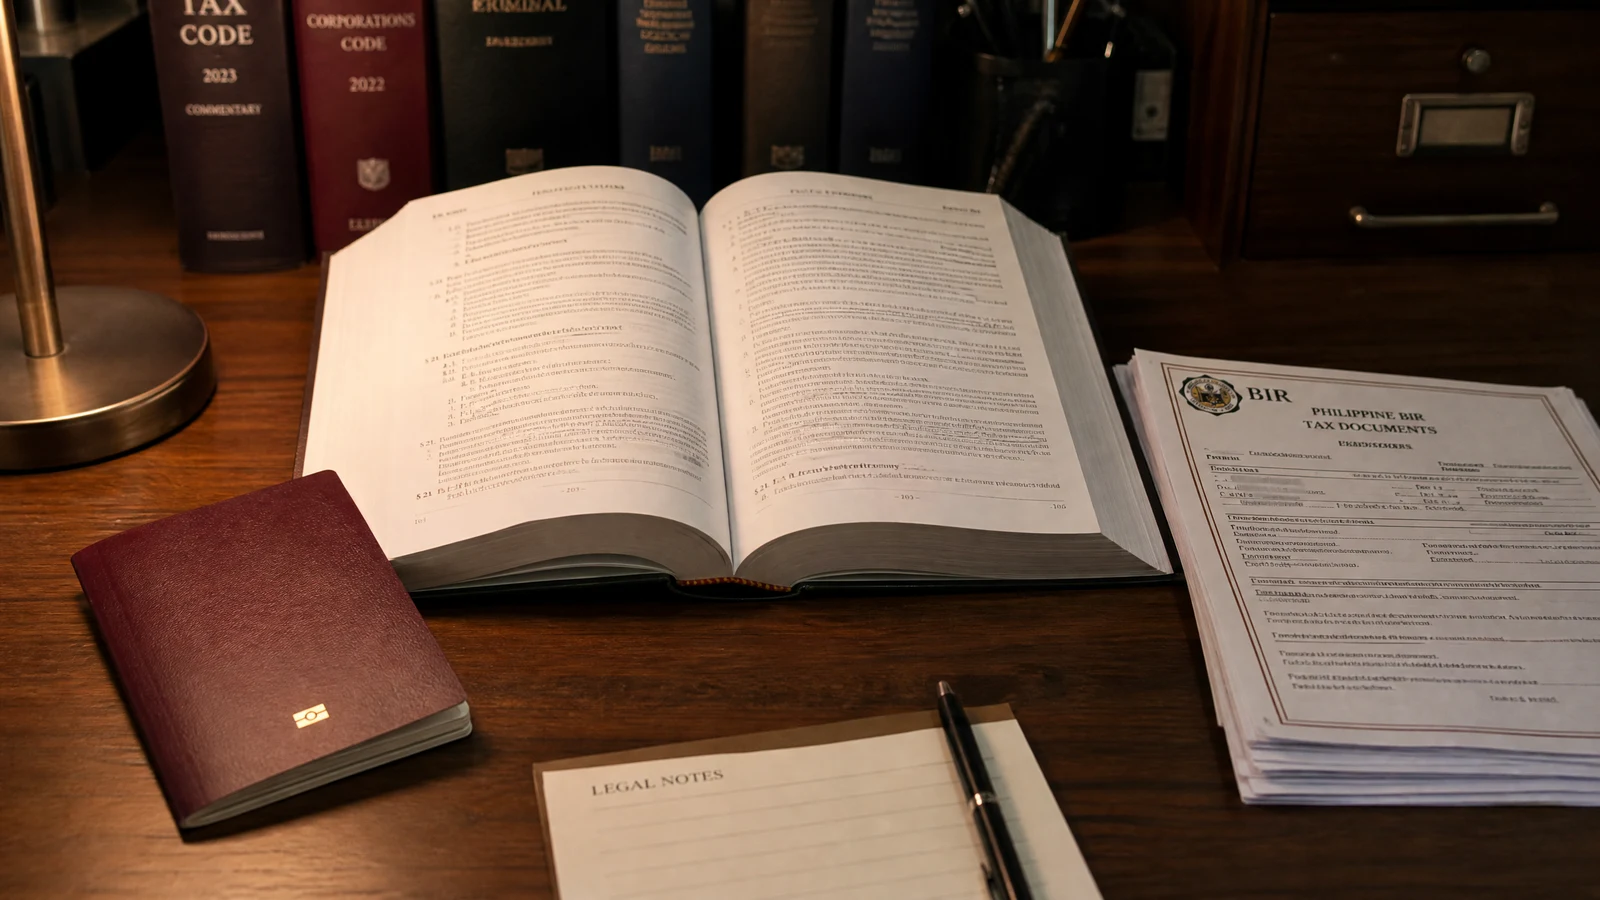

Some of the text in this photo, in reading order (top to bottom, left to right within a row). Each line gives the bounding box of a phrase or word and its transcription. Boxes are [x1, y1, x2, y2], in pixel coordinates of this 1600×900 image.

[183, 0, 248, 16] TAX
[306, 13, 416, 29] CORPORATIONS
[180, 24, 254, 46] CODE
[340, 36, 387, 52] CODE
[202, 68, 238, 84] 2023
[349, 77, 386, 92] 2022
[185, 103, 262, 116] COMMENTARY
[1246, 387, 1293, 403] BIR
[1311, 407, 1426, 421] PHILIPPINE BIR
[1302, 420, 1438, 435] TAX DOCUMENTS
[591, 769, 724, 796] LEGAL NOTES
